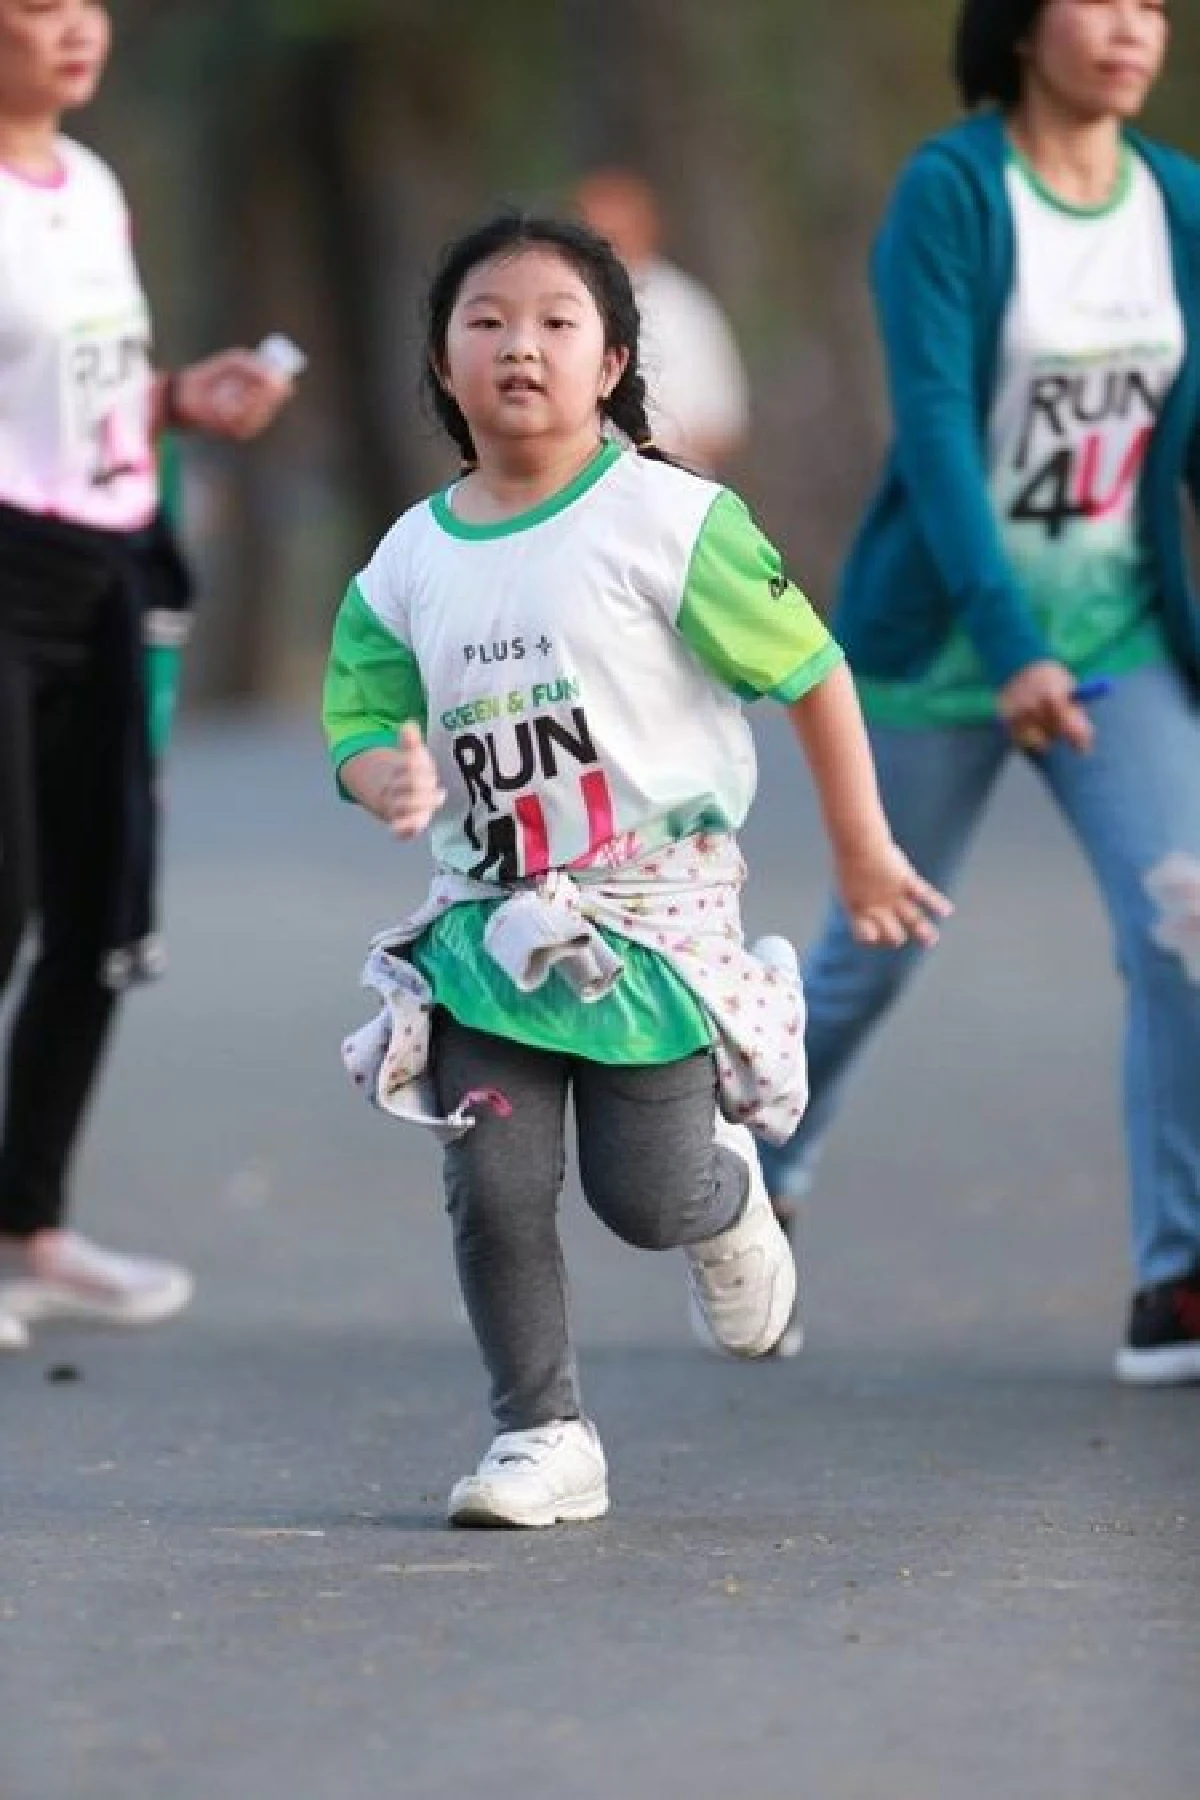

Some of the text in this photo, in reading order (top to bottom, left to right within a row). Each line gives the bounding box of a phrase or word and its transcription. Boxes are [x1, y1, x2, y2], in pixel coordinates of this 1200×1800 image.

[1008, 428, 1153, 541] 4U
[463, 636, 526, 665] PLUS
[507, 690, 524, 714] &
[532, 677, 580, 708] FUN
[453, 706, 599, 813] RUN
